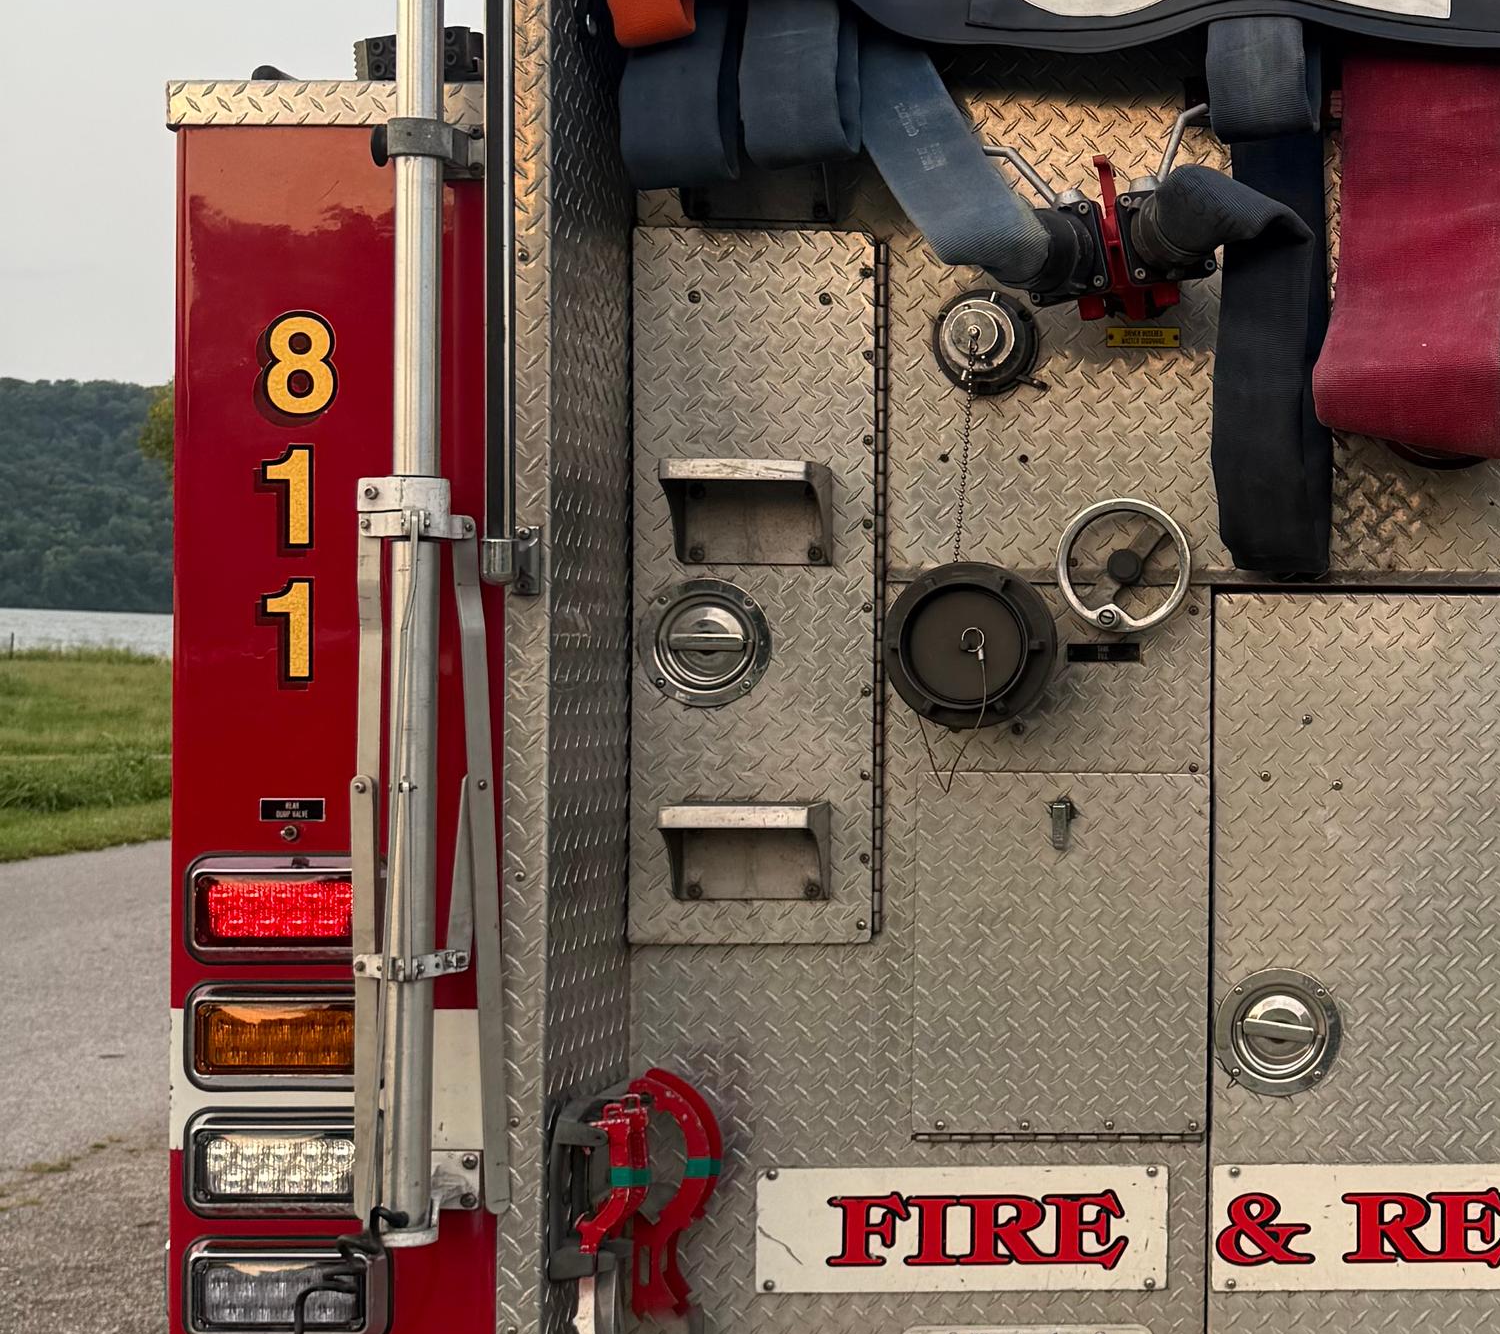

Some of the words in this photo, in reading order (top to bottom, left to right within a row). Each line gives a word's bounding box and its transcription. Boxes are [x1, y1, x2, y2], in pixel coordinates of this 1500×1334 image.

[259, 310, 338, 685] 811
[827, 1190, 1128, 1270] FIRE
[1215, 1192, 1316, 1267] &
